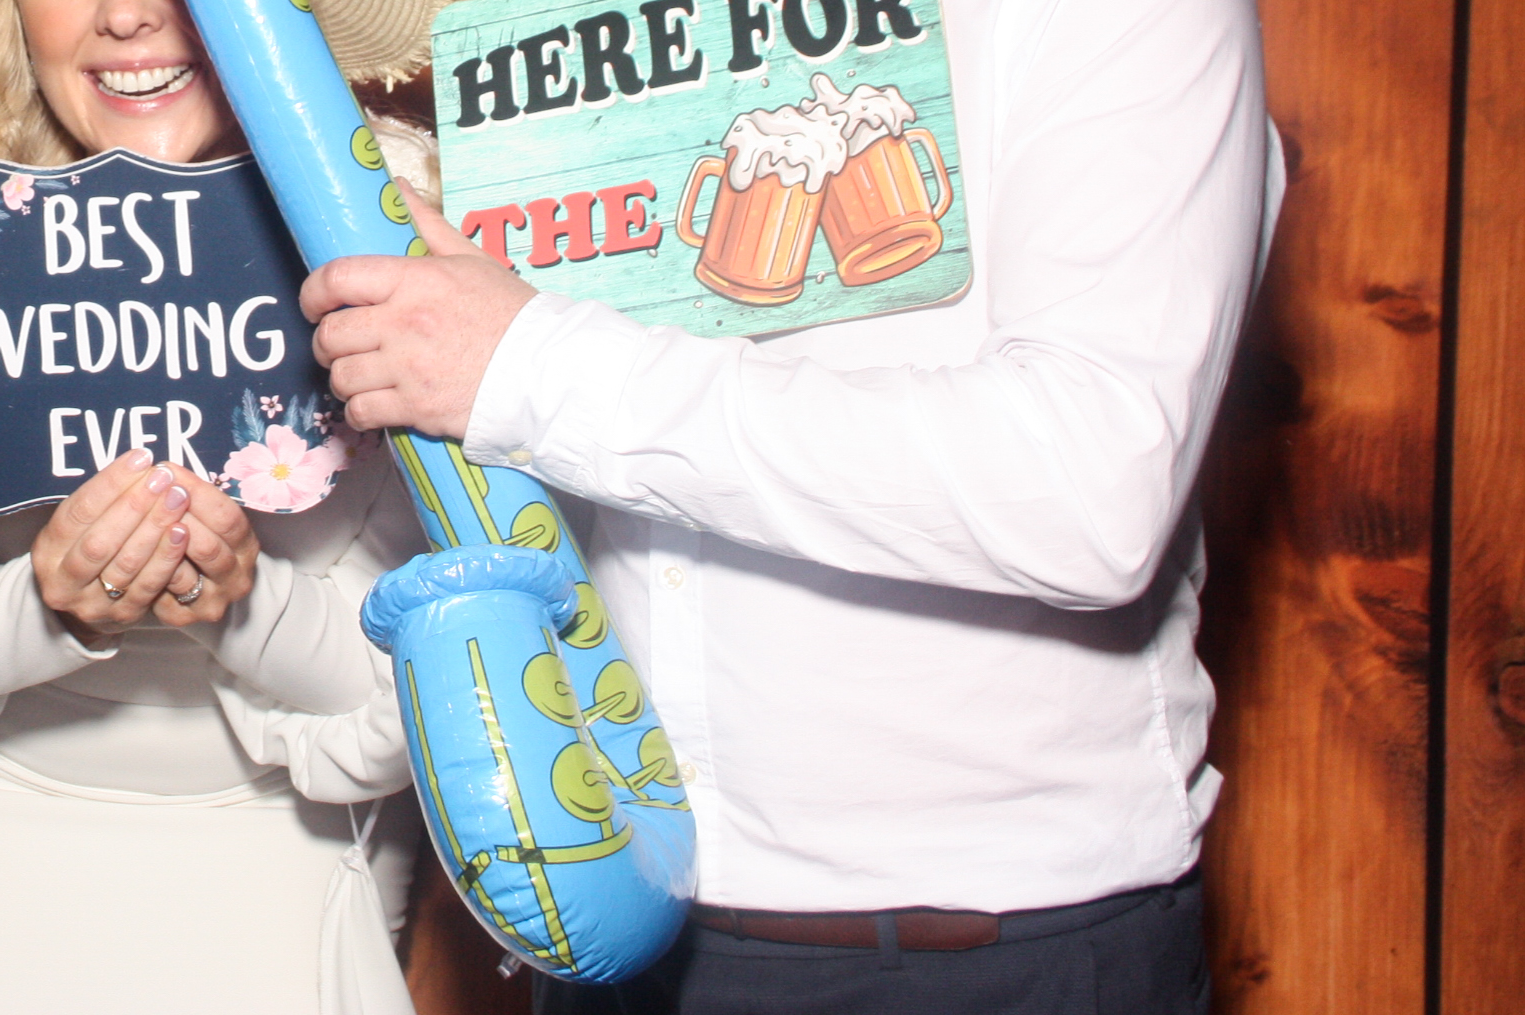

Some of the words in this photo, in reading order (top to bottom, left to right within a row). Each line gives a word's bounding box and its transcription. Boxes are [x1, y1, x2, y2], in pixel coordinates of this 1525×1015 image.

[43, 190, 201, 284] BEST
[460, 179, 663, 273] THE
[49, 400, 210, 478] EVER
